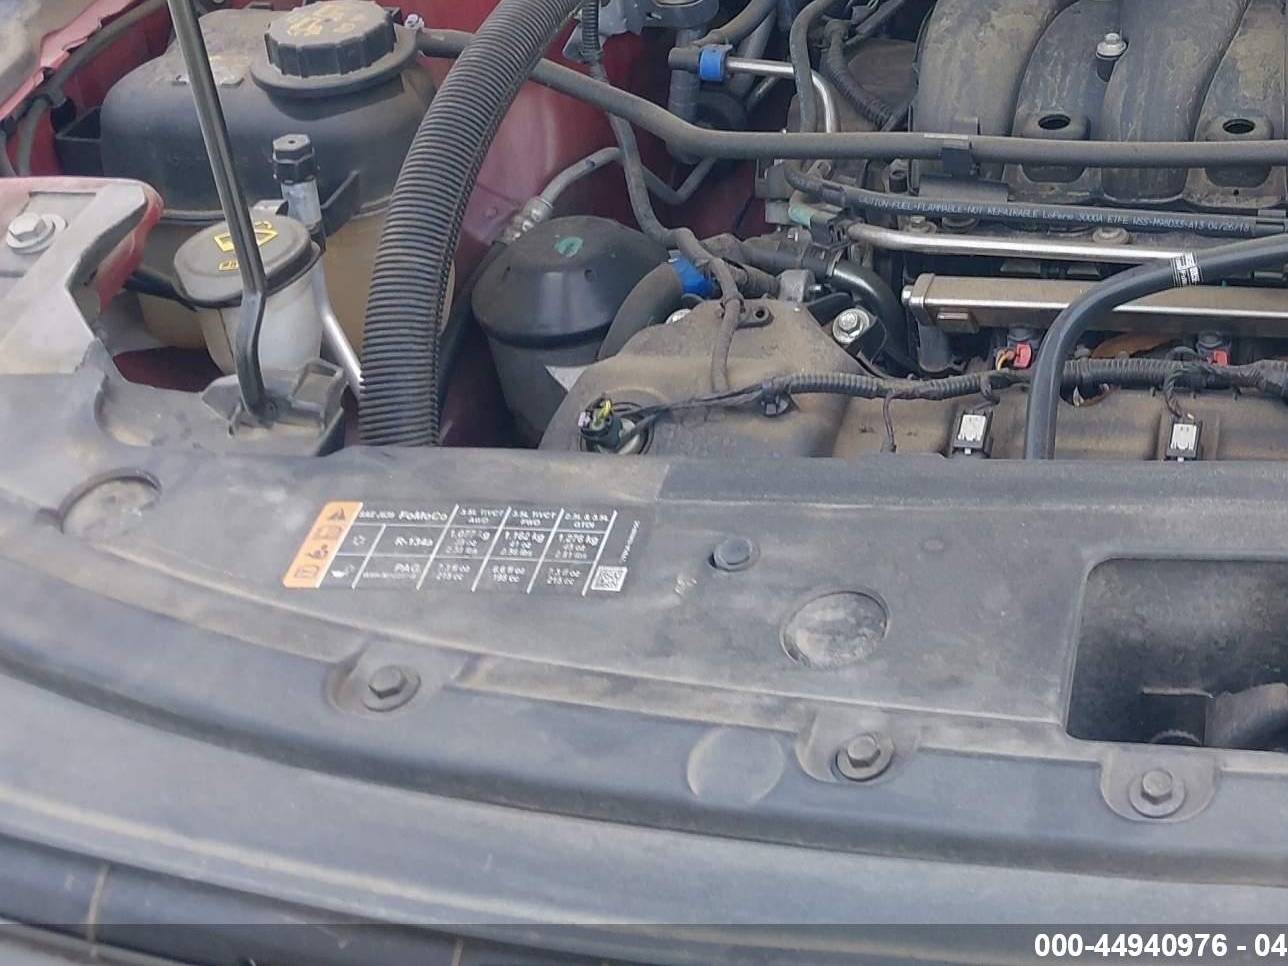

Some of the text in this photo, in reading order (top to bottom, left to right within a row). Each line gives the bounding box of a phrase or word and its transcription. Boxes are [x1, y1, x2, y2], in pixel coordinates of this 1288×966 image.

[398, 510, 449, 521] FoMoCo
[394, 536, 434, 547] R-134a
[531, 532, 546, 543] kg
[585, 534, 599, 546] kg
